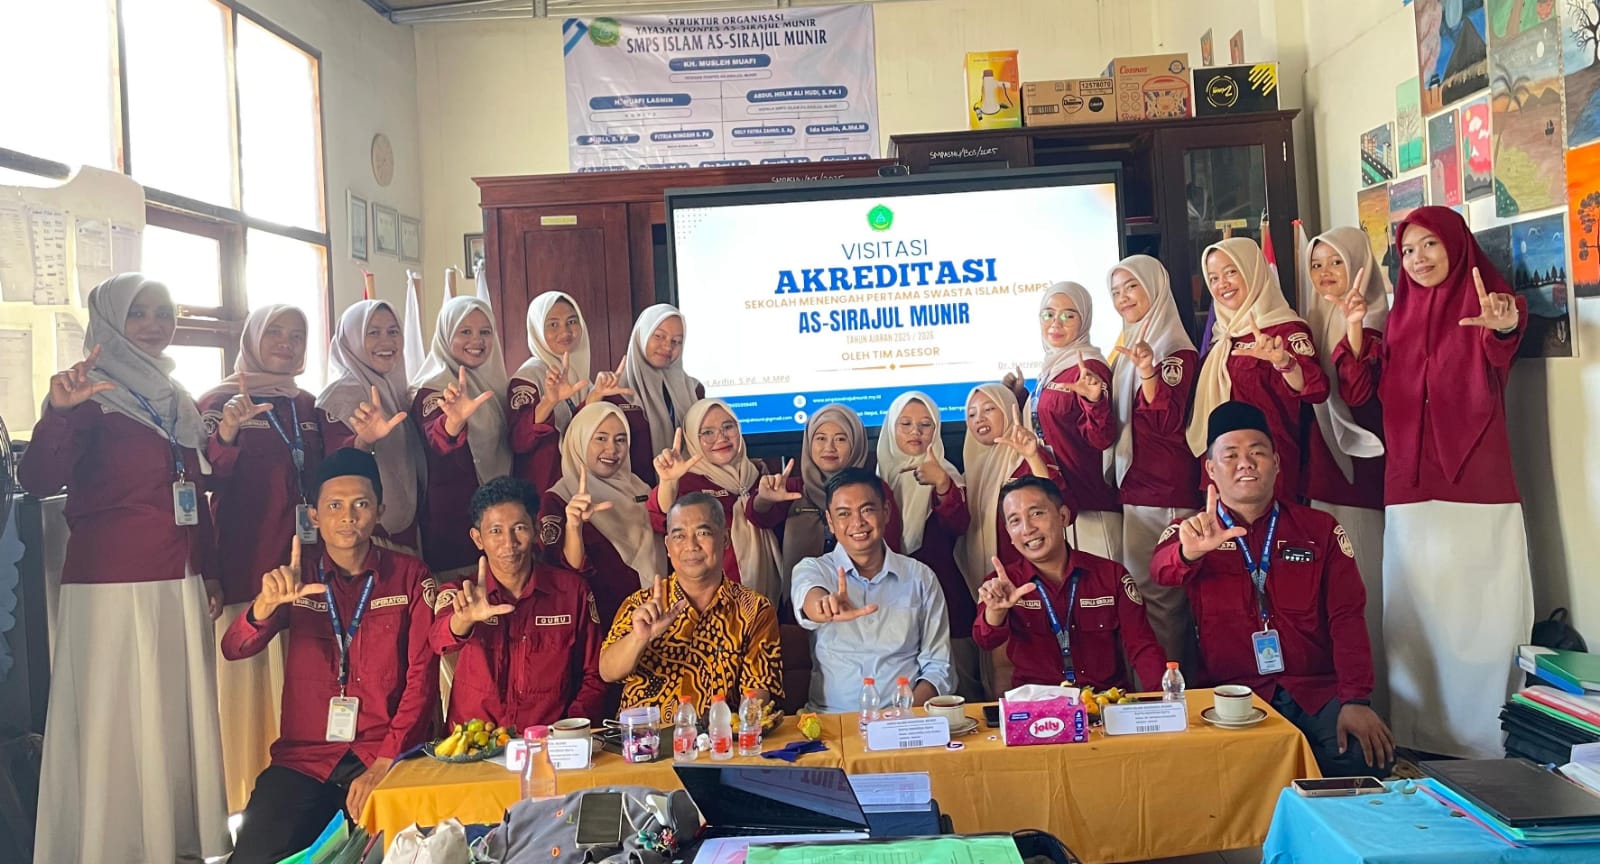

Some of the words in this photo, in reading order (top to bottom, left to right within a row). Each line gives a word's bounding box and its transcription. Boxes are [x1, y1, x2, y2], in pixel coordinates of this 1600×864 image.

[636, 26, 680, 34] YAYASAN
[783, 19, 816, 28] MUNIR
[669, 16, 719, 26] STRUKTUR
[723, 14, 784, 25] ORGANISASI
[627, 37, 659, 53] SMPS
[664, 34, 703, 51] ISLAM
[707, 31, 780, 50] AS-SIRAJUL
[784, 29, 827, 45] MUNIR
[684, 60, 697, 68] KH.
[699, 59, 731, 67] MUSLEH
[732, 58, 757, 66] MUAFI
[841, 239, 928, 260] VISITASI
[775, 258, 997, 294] AKREDITASI
[745, 297, 797, 310] SEKOLAH
[799, 293, 864, 307] MENENGAH
[867, 290, 921, 303] PERTAMA
[923, 287, 973, 300] SWASTA
[975, 284, 1010, 297] ISLAM
[798, 305, 904, 334] AS-SIRAJUL
[910, 302, 970, 328] MUNIR
[846, 335, 868, 345] TAHUN
[894, 332, 911, 343] 2025
[918, 331, 934, 341] 2026
[841, 351, 870, 362] OLEH
[872, 350, 893, 360] TIM
[896, 347, 941, 358] ASESOR
[541, 616, 567, 625] GURU
[1034, 721, 1060, 735] jolly
